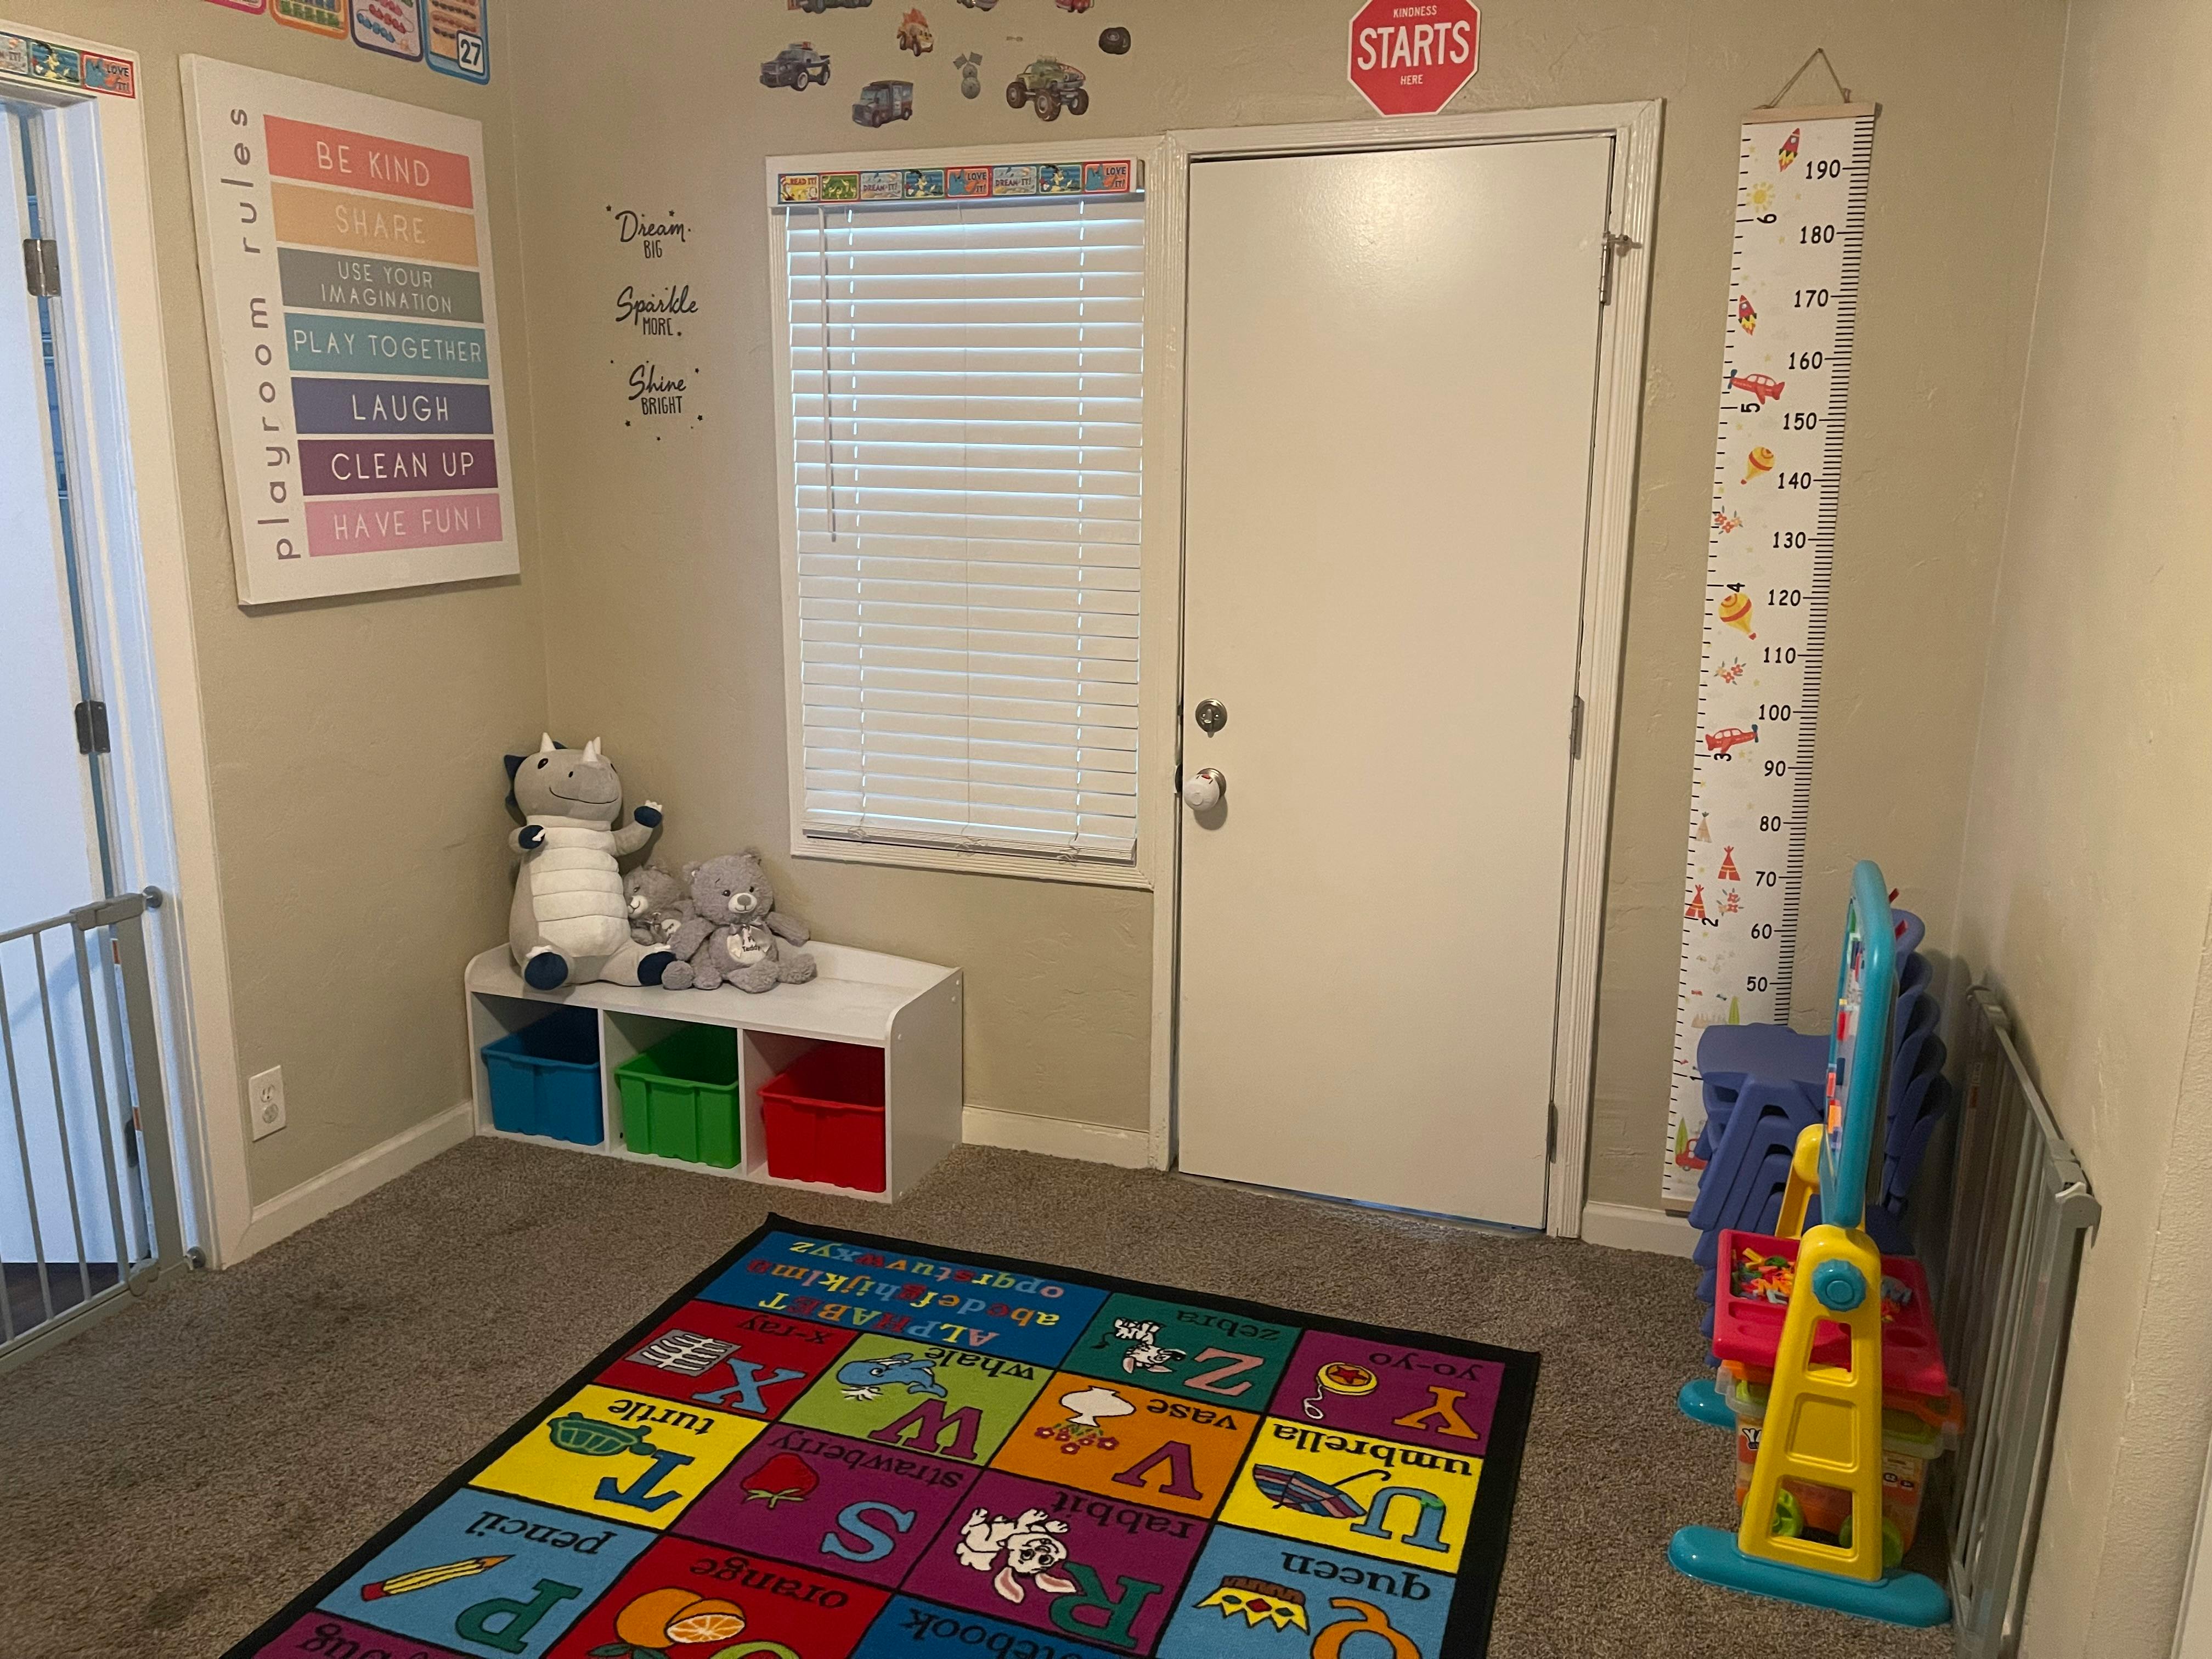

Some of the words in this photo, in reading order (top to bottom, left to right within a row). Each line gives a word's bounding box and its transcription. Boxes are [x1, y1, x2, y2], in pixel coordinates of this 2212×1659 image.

[1393, 5, 1437, 18] KINDNESS
[461, 39, 481, 65] 27
[1357, 20, 1470, 70] STARTS
[106, 64, 129, 77] LOVE
[1401, 75, 1423, 85] HERE
[117, 82, 129, 91] IT!
[317, 141, 352, 173] BE
[369, 151, 430, 187] KIND
[967, 172, 986, 180] LOVE
[1106, 166, 1126, 176] LOVE
[1805, 159, 1841, 180] 190
[221, 108, 261, 254] rules
[975, 183, 986, 193] IT!
[1021, 177, 1031, 185] IT!
[1114, 179, 1125, 188] IT!
[336, 206, 425, 245] SHARE
[615, 210, 686, 242] Dream
[1757, 213, 1777, 224] 6
[1800, 225, 1835, 244] 180
[644, 240, 663, 259] BIG
[338, 261, 372, 283] USE
[384, 267, 433, 288] YOUR
[321, 284, 452, 314] IMAGINATION
[616, 285, 698, 325] Sparkle
[1794, 289, 1829, 308] 170
[643, 318, 673, 336] MORE
[295, 330, 356, 356] PLAY
[368, 336, 482, 363] TOGETHER
[1788, 352, 1823, 370] 160
[629, 364, 686, 400] Shine
[352, 395, 448, 421] LAUGH
[641, 396, 682, 415] BRIGHT
[1741, 403, 1760, 414] 5
[249, 297, 301, 560] playroom
[1783, 413, 1817, 430] 150
[331, 453, 428, 480] CLEAN
[443, 452, 474, 477] UP
[1778, 472, 1812, 489] 140
[334, 510, 404, 540] HAVE
[424, 505, 481, 534] FUN!
[1773, 532, 1806, 549] 130
[1726, 583, 1745, 592] 4
[1768, 589, 1801, 606] 120
[1763, 647, 1796, 664] 110
[1758, 704, 1791, 721] 100
[1714, 753, 1733, 761] 3
[1763, 760, 1786, 777] 90
[1759, 816, 1782, 832] 80
[1754, 871, 1777, 887] 70
[1702, 917, 1718, 928] 2
[1751, 924, 1773, 940] 60
[1746, 977, 1768, 992] 50
[737, 1315, 835, 1345] x-ray
[758, 1291, 1000, 1348] ALPHABET
[1176, 1310, 1281, 1340] zebra
[924, 1346, 1035, 1380] whale
[1183, 1347, 1265, 1396] Z
[1369, 1352, 1484, 1381] yo-yo
[691, 1357, 806, 1414] X
[607, 1399, 715, 1435] turtle
[1146, 1398, 1238, 1430] vase
[1392, 1385, 1479, 1440] Y
[867, 1397, 983, 1461] W
[770, 1430, 964, 1488] strawberry
[1273, 1423, 1472, 1476] umbrella
[594, 1449, 696, 1512] T
[1111, 1440, 1203, 1501] V
[1051, 1491, 1195, 1539] rabbit
[1350, 1486, 1451, 1553] U
[465, 1510, 618, 1554] pencil
[821, 1500, 917, 1562] S
[690, 1556, 848, 1609] orange
[1282, 1551, 1430, 1600] queen
[454, 1578, 583, 1655] P
[1049, 1561, 1165, 1649] R
